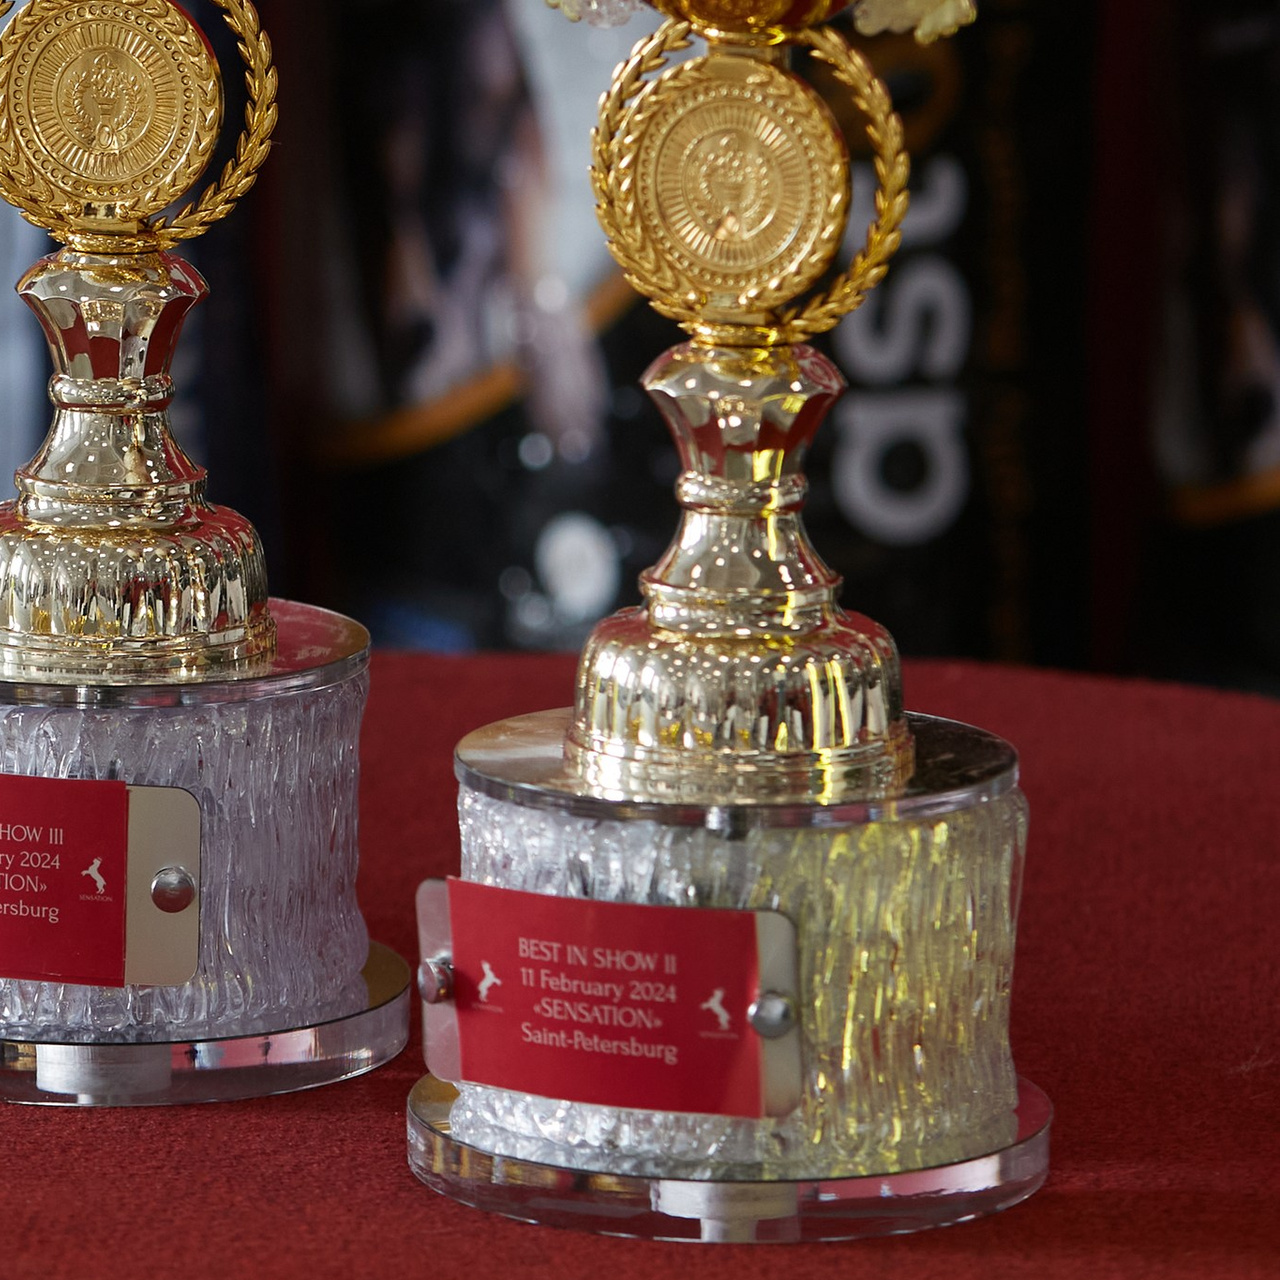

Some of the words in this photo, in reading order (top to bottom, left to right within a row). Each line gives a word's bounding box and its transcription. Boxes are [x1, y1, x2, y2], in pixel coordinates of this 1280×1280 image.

[50, 828, 63, 844] III
[20, 851, 60, 869] 2024
[519, 937, 561, 962] BEST
[567, 945, 587, 966] IN
[593, 948, 657, 971] SHOW
[664, 954, 676, 974] II
[520, 967, 534, 986] 11
[540, 969, 623, 1001] February
[630, 980, 676, 1002] 2024
[533, 997, 661, 1028] «SENSATION»
[521, 1021, 677, 1064] Saint-Petersburg
